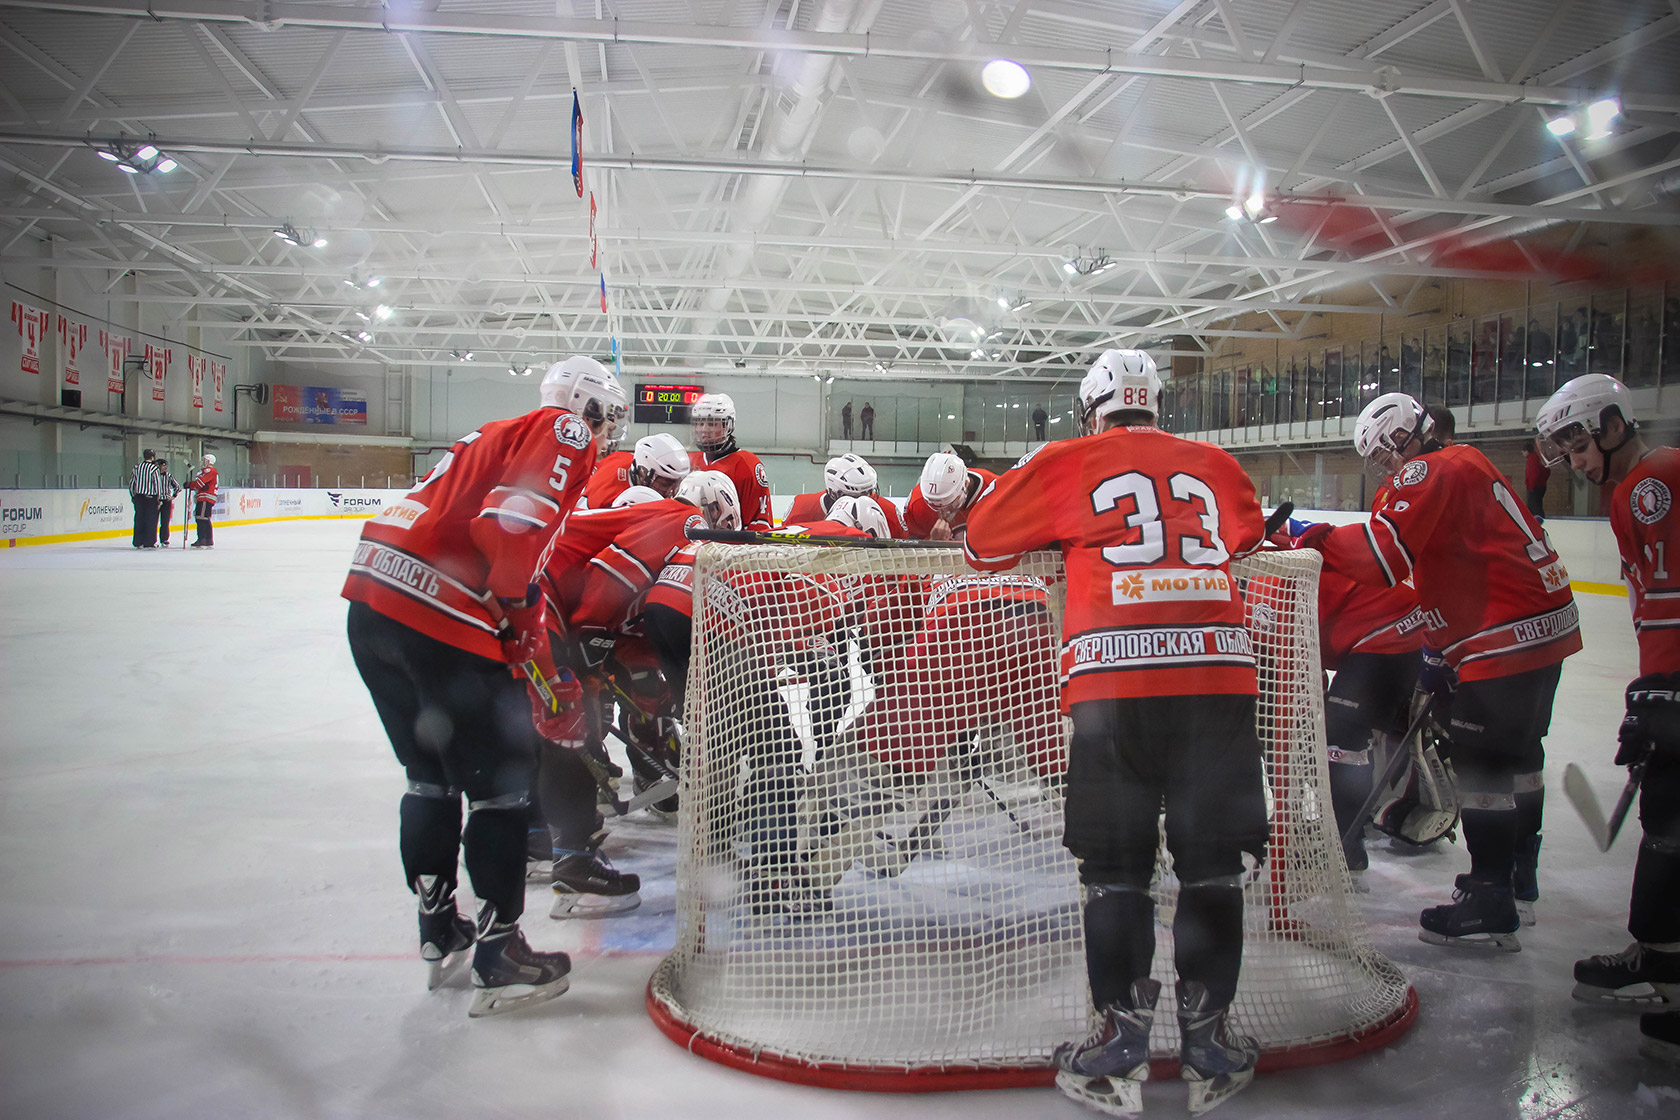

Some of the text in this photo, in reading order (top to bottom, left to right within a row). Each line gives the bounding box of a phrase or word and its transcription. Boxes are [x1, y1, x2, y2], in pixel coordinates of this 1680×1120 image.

[646, 391, 654, 402] 0
[691, 392, 698, 402] 0
[1123, 387, 1148, 406] 88
[282, 405, 330, 415] РОЖДЕННЫЕ
[548, 453, 572, 492] 5
[929, 482, 937, 494] 71
[88, 503, 124, 515] СОЛНЕЧНЫЙ
[343, 498, 382, 506] FORUM
[2, 507, 43, 521] FORUM
[383, 505, 419, 521] ОТИВ
[1089, 469, 1230, 567] 33
[2, 524, 27, 534] GROUP
[1492, 480, 1555, 563] 1
[771, 532, 811, 540] CCM
[371, 547, 440, 597] ОБЛАСТЬ
[1152, 576, 1229, 592] МОТИВ
[1074, 630, 1255, 664] СВЕРДЛОВСКАЯ ОБЛАС
